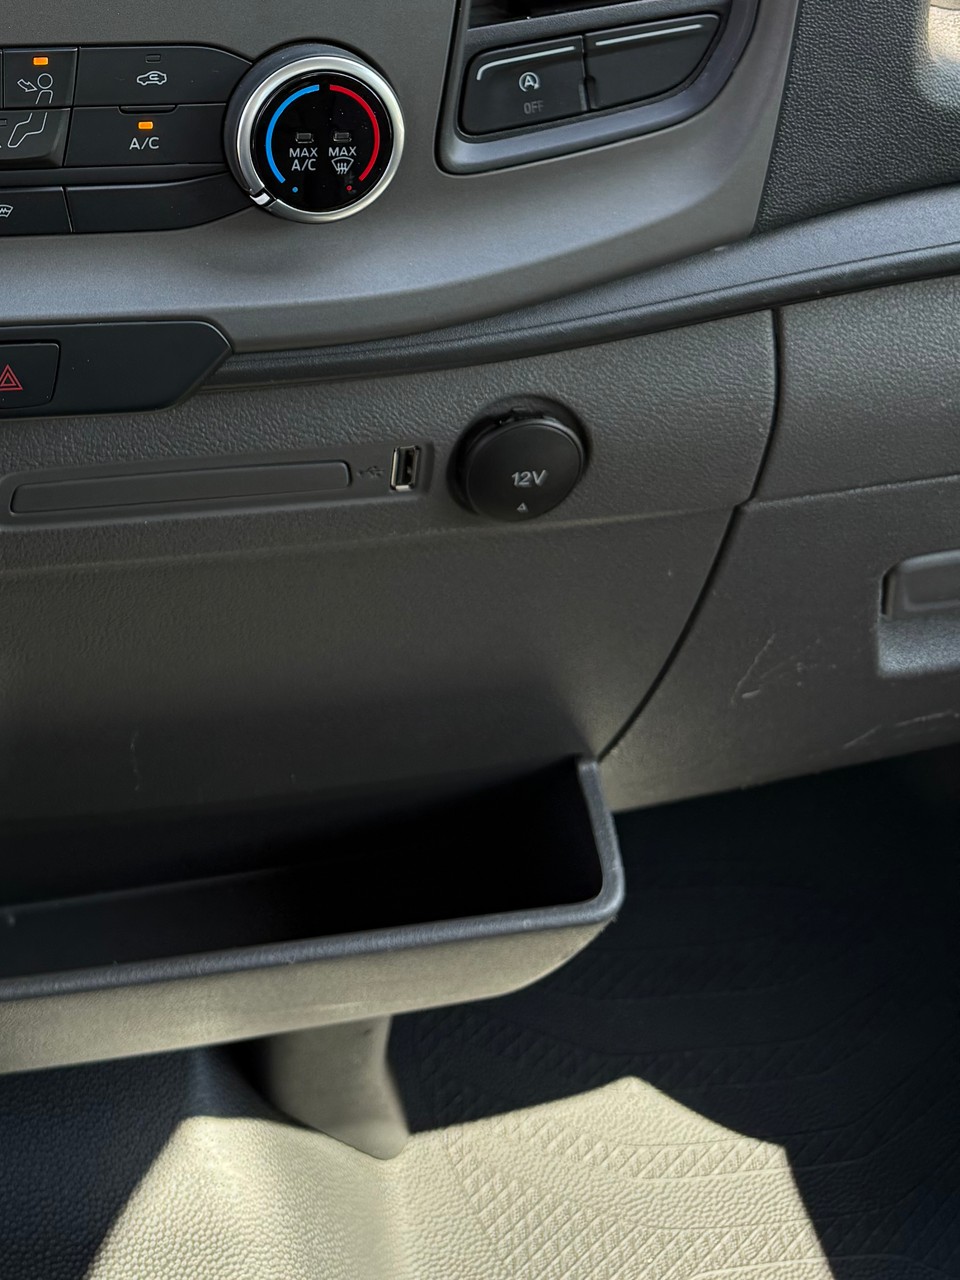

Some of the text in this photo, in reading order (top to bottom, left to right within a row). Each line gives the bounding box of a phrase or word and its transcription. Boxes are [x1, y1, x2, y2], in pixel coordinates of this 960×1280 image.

[523, 100, 544, 115] OFF
[129, 137, 160, 150] A/C
[289, 147, 318, 158] MAX
[328, 146, 357, 157] MAX
[291, 158, 317, 172] A/C
[511, 469, 546, 487] 12V
